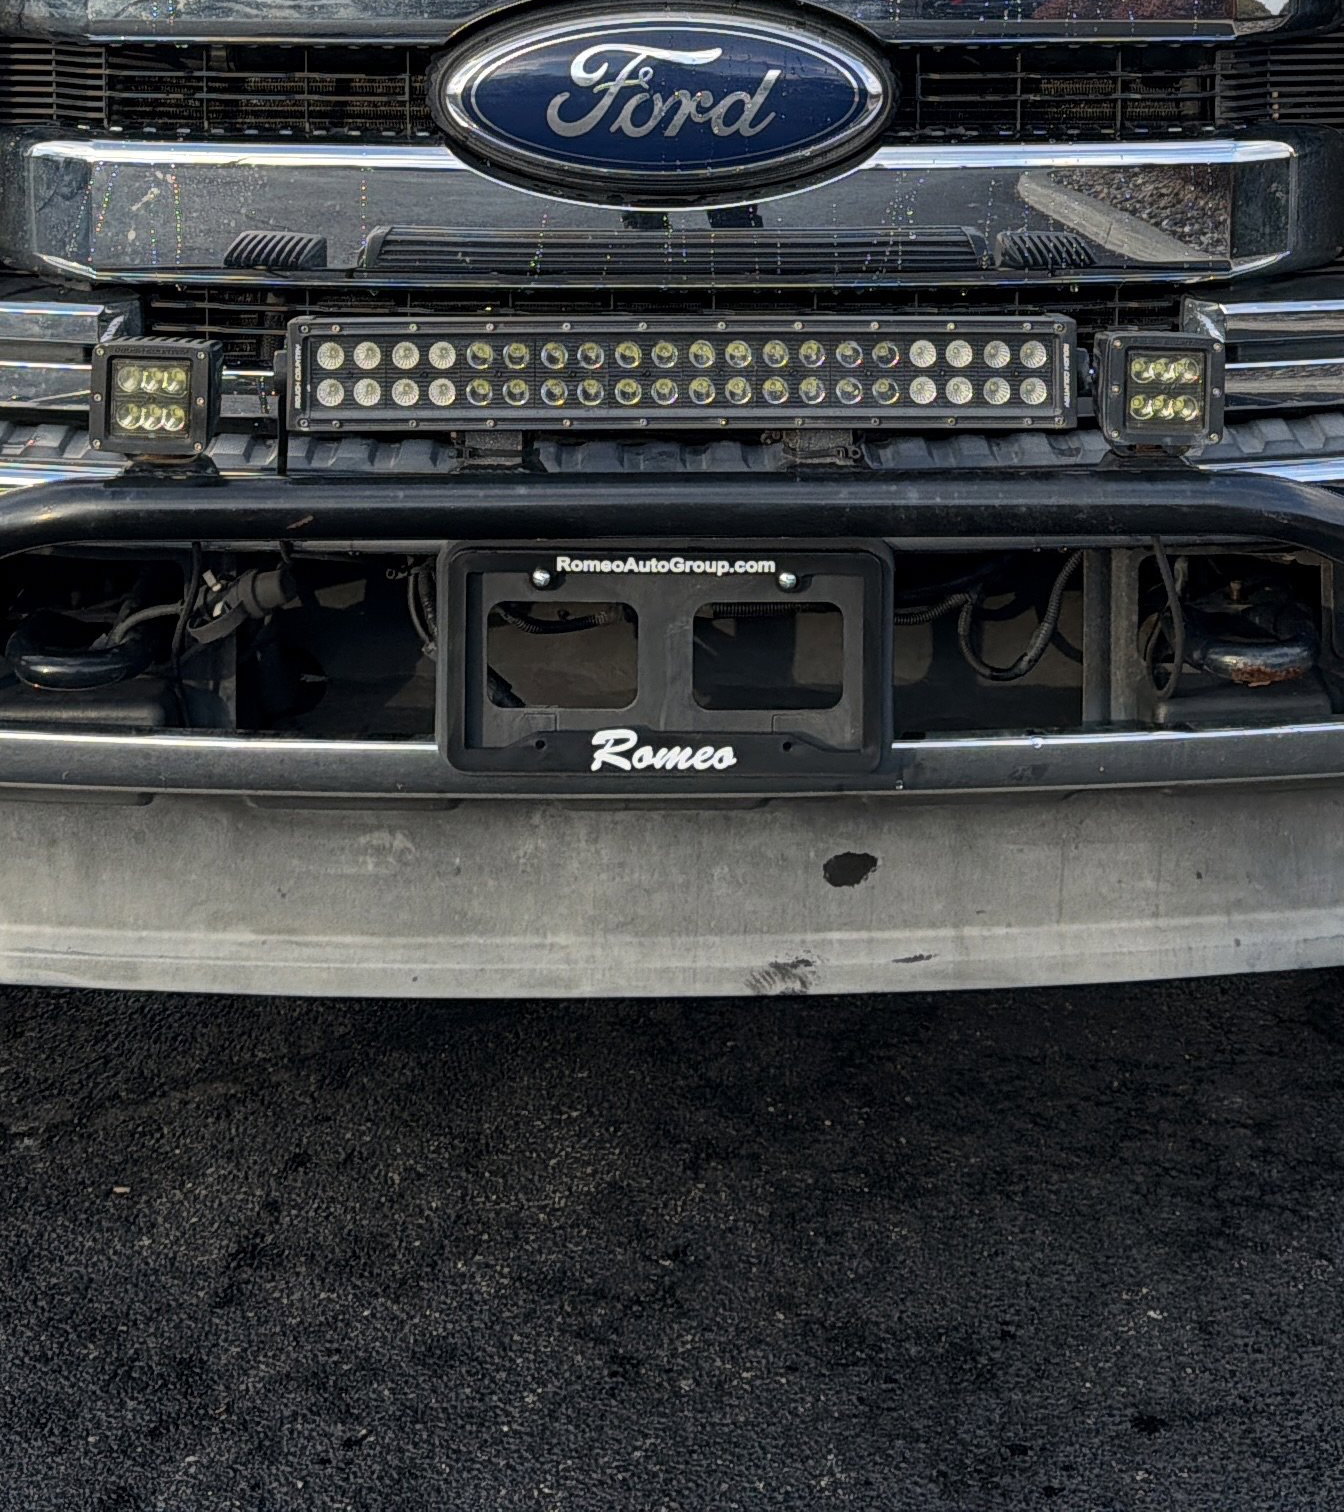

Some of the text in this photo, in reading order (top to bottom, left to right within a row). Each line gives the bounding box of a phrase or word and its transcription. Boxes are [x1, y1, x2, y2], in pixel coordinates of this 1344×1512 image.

[545, 43, 783, 138] Ford
[556, 556, 776, 576] RomeoAutoGroup.com
[590, 728, 737, 772] Romeo
